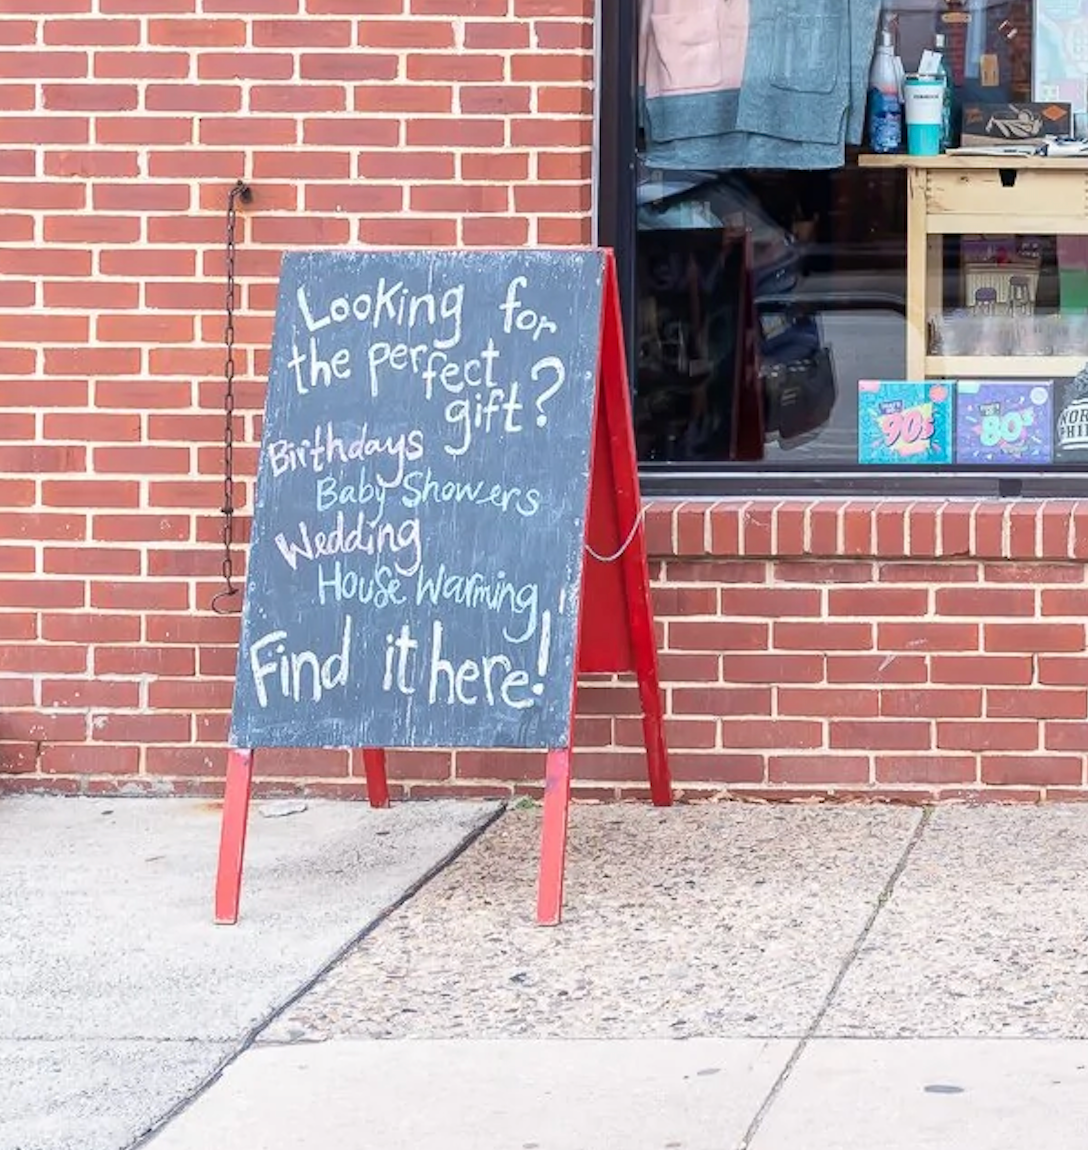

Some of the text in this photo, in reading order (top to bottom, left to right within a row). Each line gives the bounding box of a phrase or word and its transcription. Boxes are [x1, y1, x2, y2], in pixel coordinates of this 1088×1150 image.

[297, 276, 557, 349] Looking for
[288, 337, 500, 400] the perfect
[445, 356, 566, 456] gift?
[267, 421, 424, 489] Birthdays
[316, 466, 541, 523] Baby Showers
[274, 511, 421, 577] Wedding
[318, 561, 539, 644] House Warming
[249, 609, 552, 709] Find it here!
